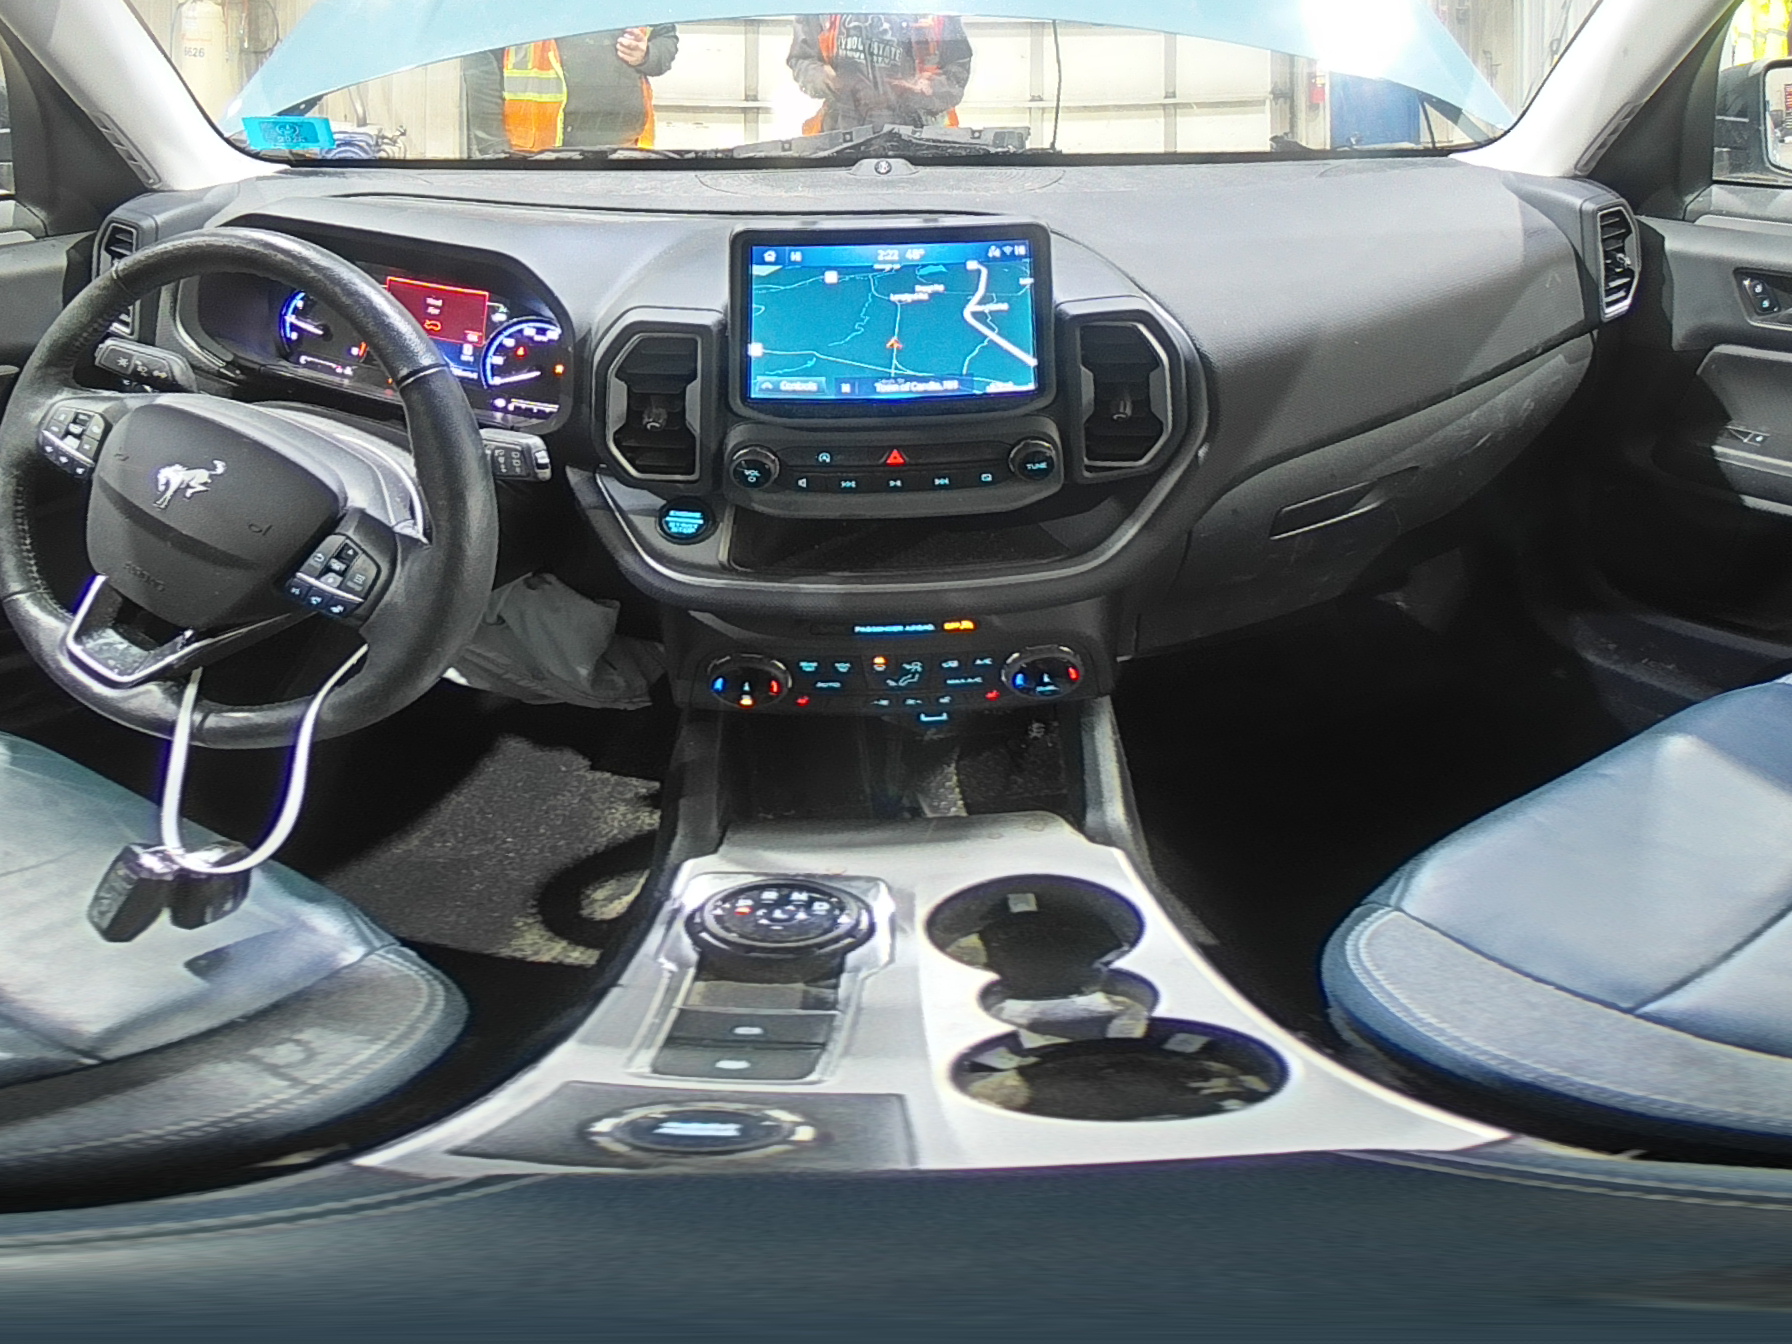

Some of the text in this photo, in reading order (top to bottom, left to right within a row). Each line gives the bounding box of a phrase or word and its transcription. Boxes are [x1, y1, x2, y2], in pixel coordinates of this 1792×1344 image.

[877, 250, 899, 261] 2:22
[1025, 461, 1048, 470] TUNE
[744, 469, 761, 477] VOL
[854, 625, 904, 633] PASSENGER
